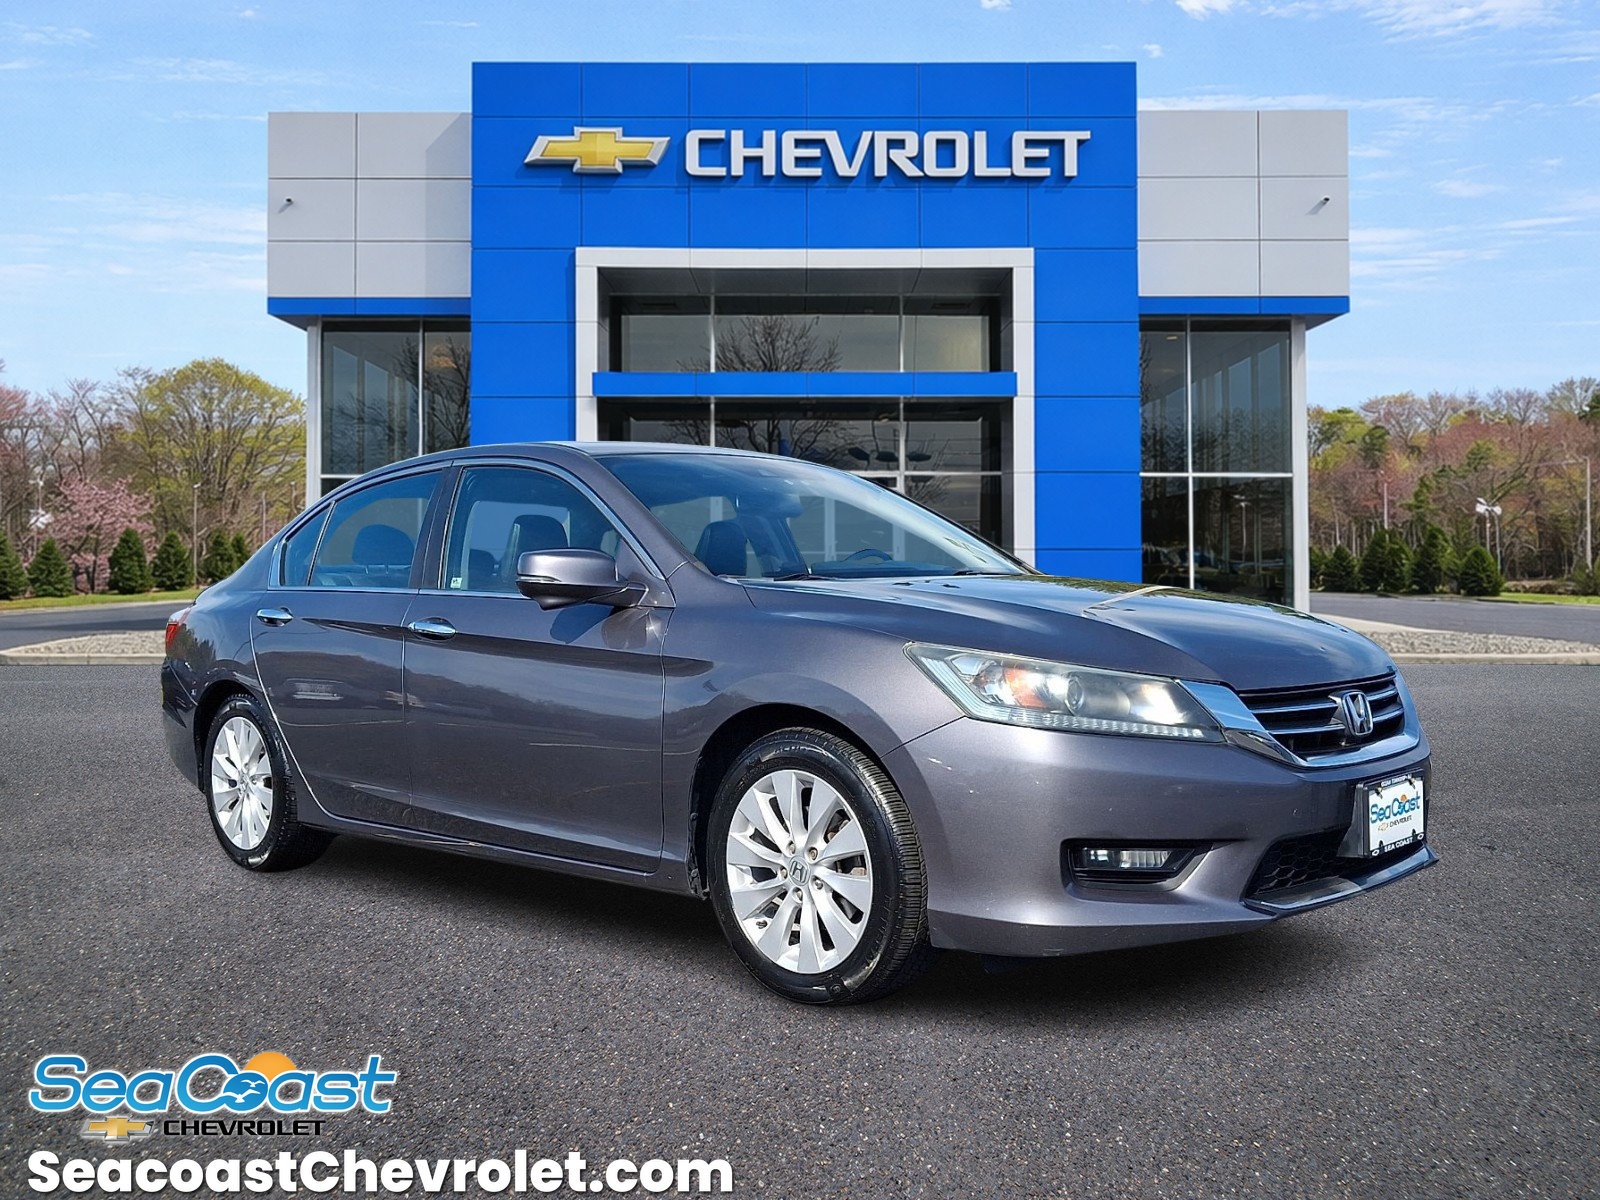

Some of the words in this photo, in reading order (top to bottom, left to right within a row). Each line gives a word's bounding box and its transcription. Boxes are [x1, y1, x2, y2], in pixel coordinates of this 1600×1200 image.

[685, 129, 1091, 178] CHEVROLET
[1384, 844, 1395, 852] SEA
[1395, 837, 1413, 848] COAST
